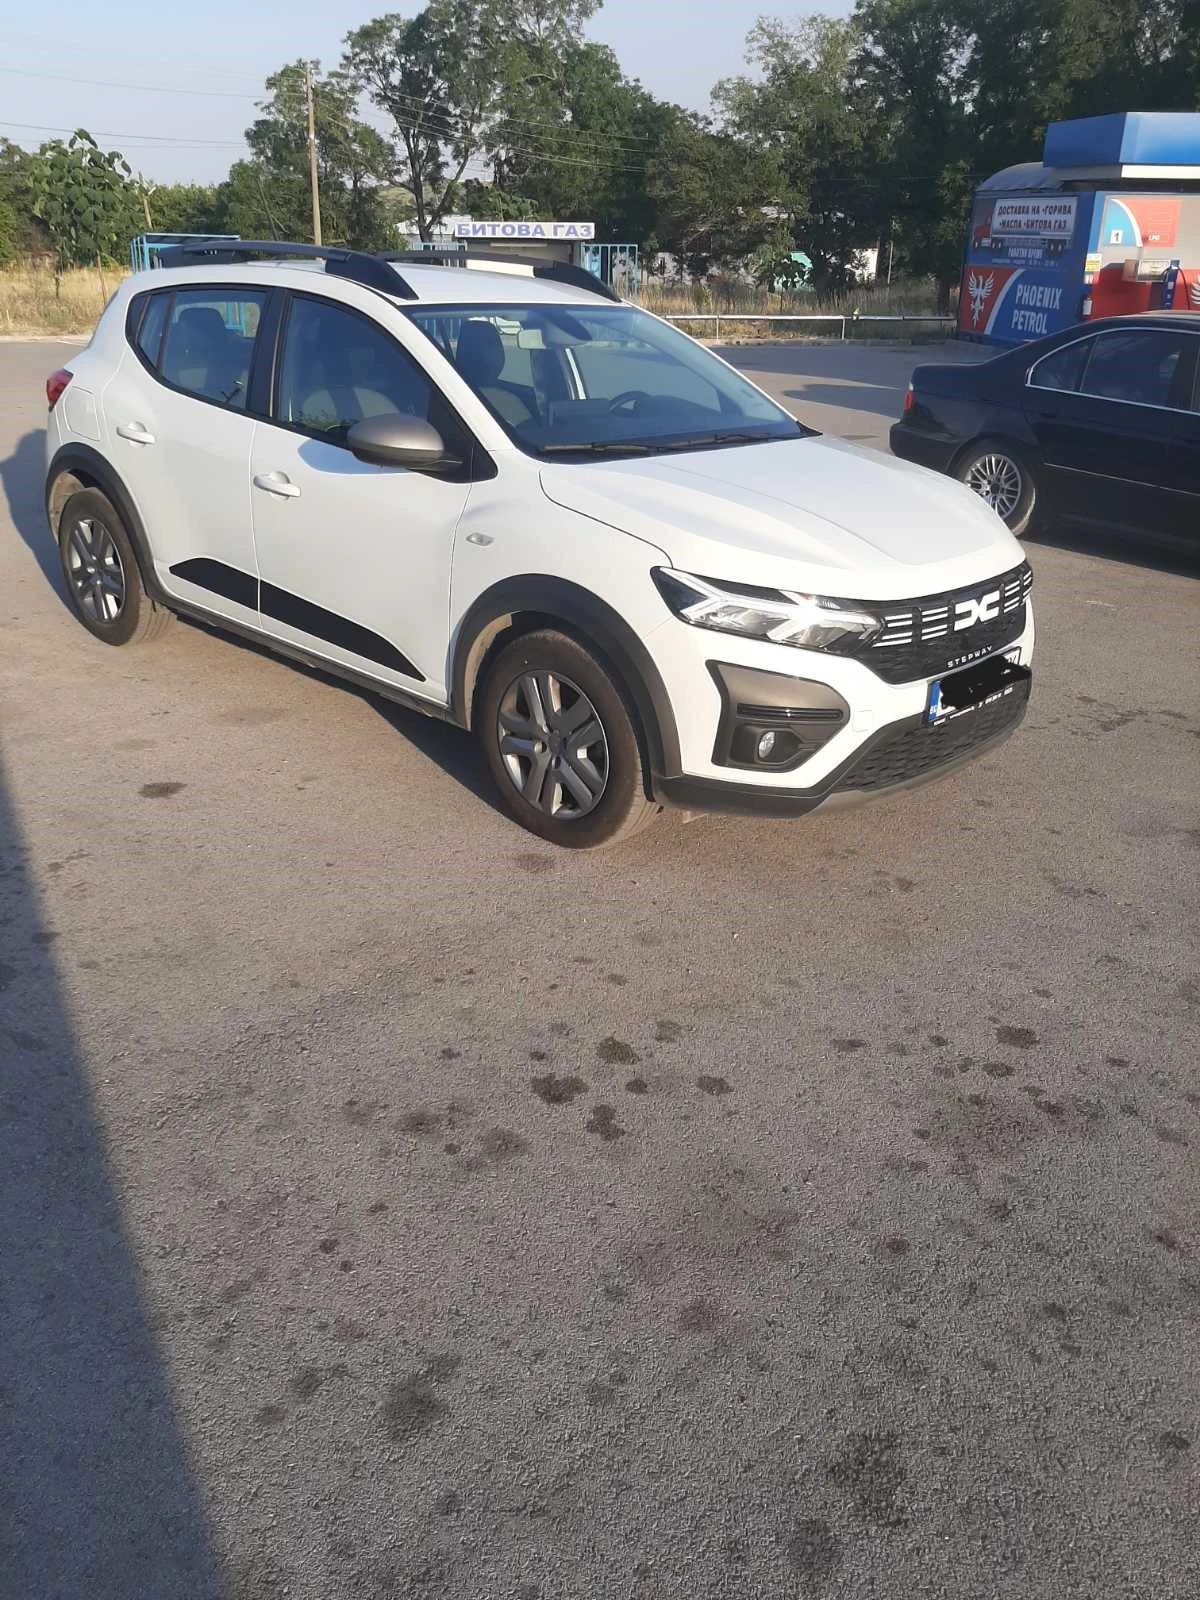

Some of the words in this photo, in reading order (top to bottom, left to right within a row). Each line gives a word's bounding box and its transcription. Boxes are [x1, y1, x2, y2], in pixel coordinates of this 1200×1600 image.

[998, 205, 1030, 216] ДОСТАВКА
[1032, 205, 1040, 215] НА
[457, 223, 546, 237] БИТОВА
[552, 224, 593, 237] ГАЗ
[1053, 220, 1067, 231] ГАЗ
[1016, 284, 1062, 310] PHOENIX
[1011, 310, 1048, 335] PETROL
[947, 645, 993, 668] STEPWAY
